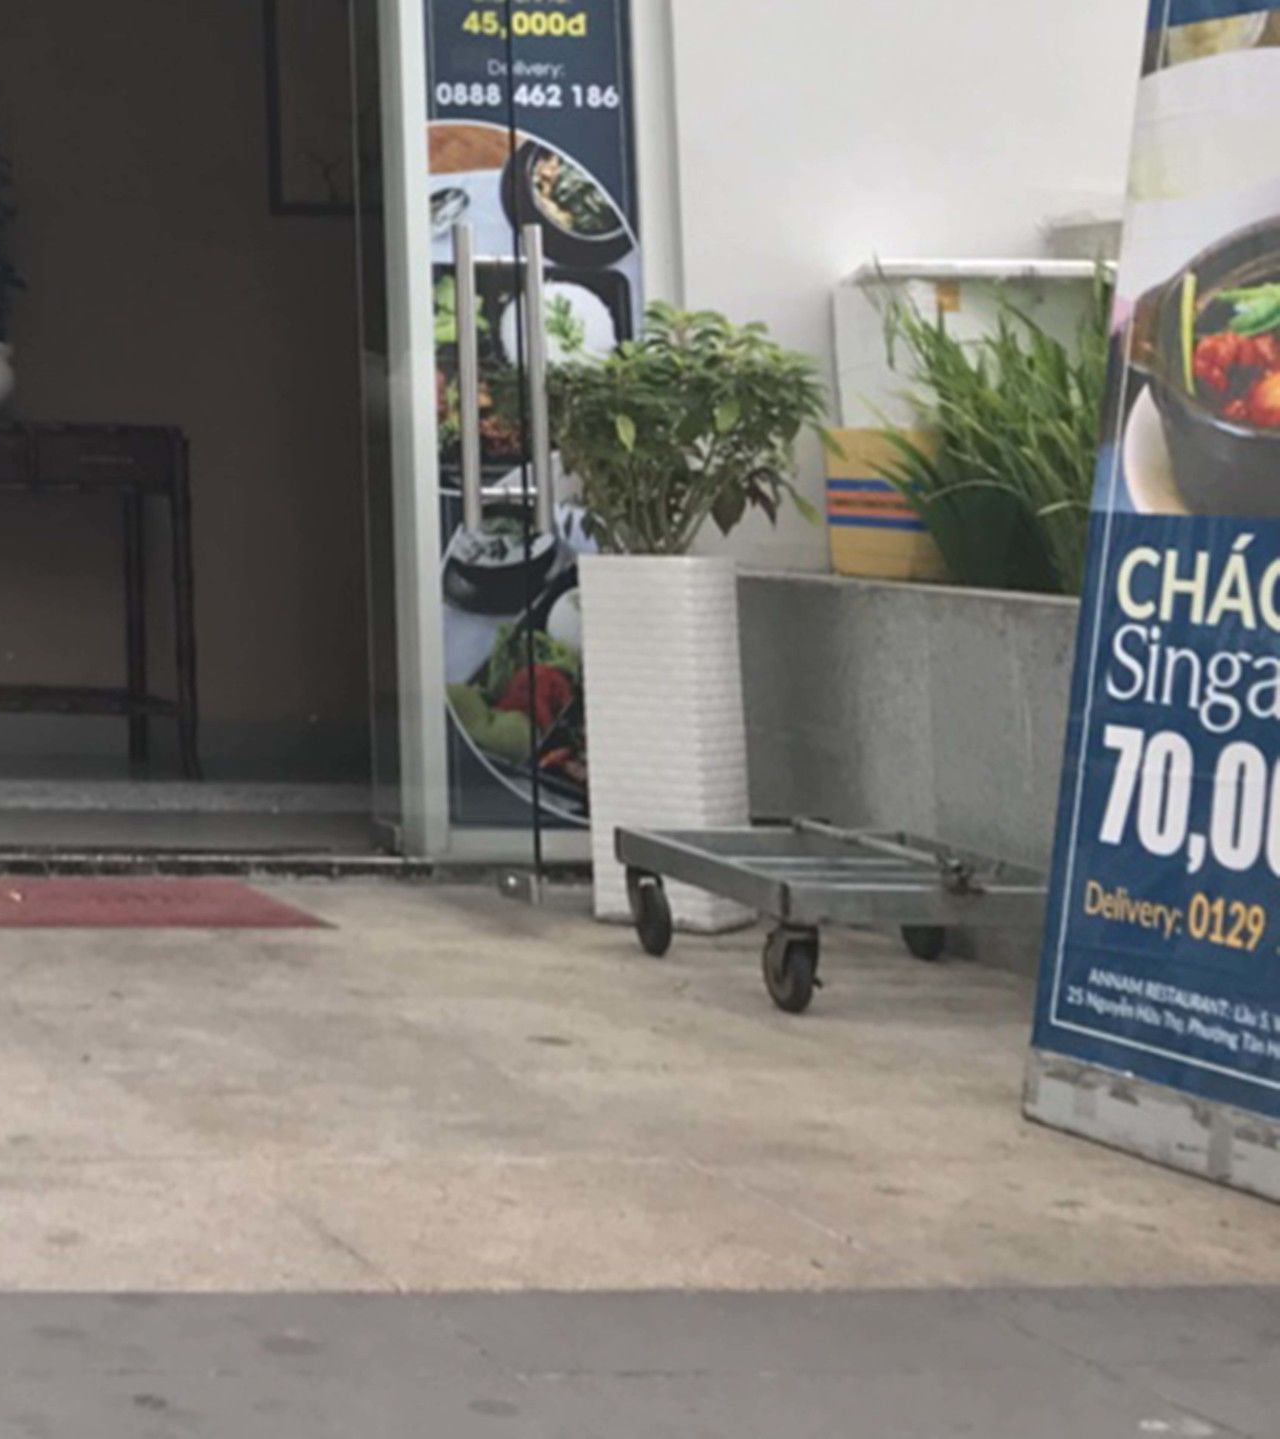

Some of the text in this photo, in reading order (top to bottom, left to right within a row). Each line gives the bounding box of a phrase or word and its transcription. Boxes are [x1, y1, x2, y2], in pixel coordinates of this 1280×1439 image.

[435, 82, 620, 109] 0888 462 186
[1083, 879, 1266, 953] Delivery: 0129
